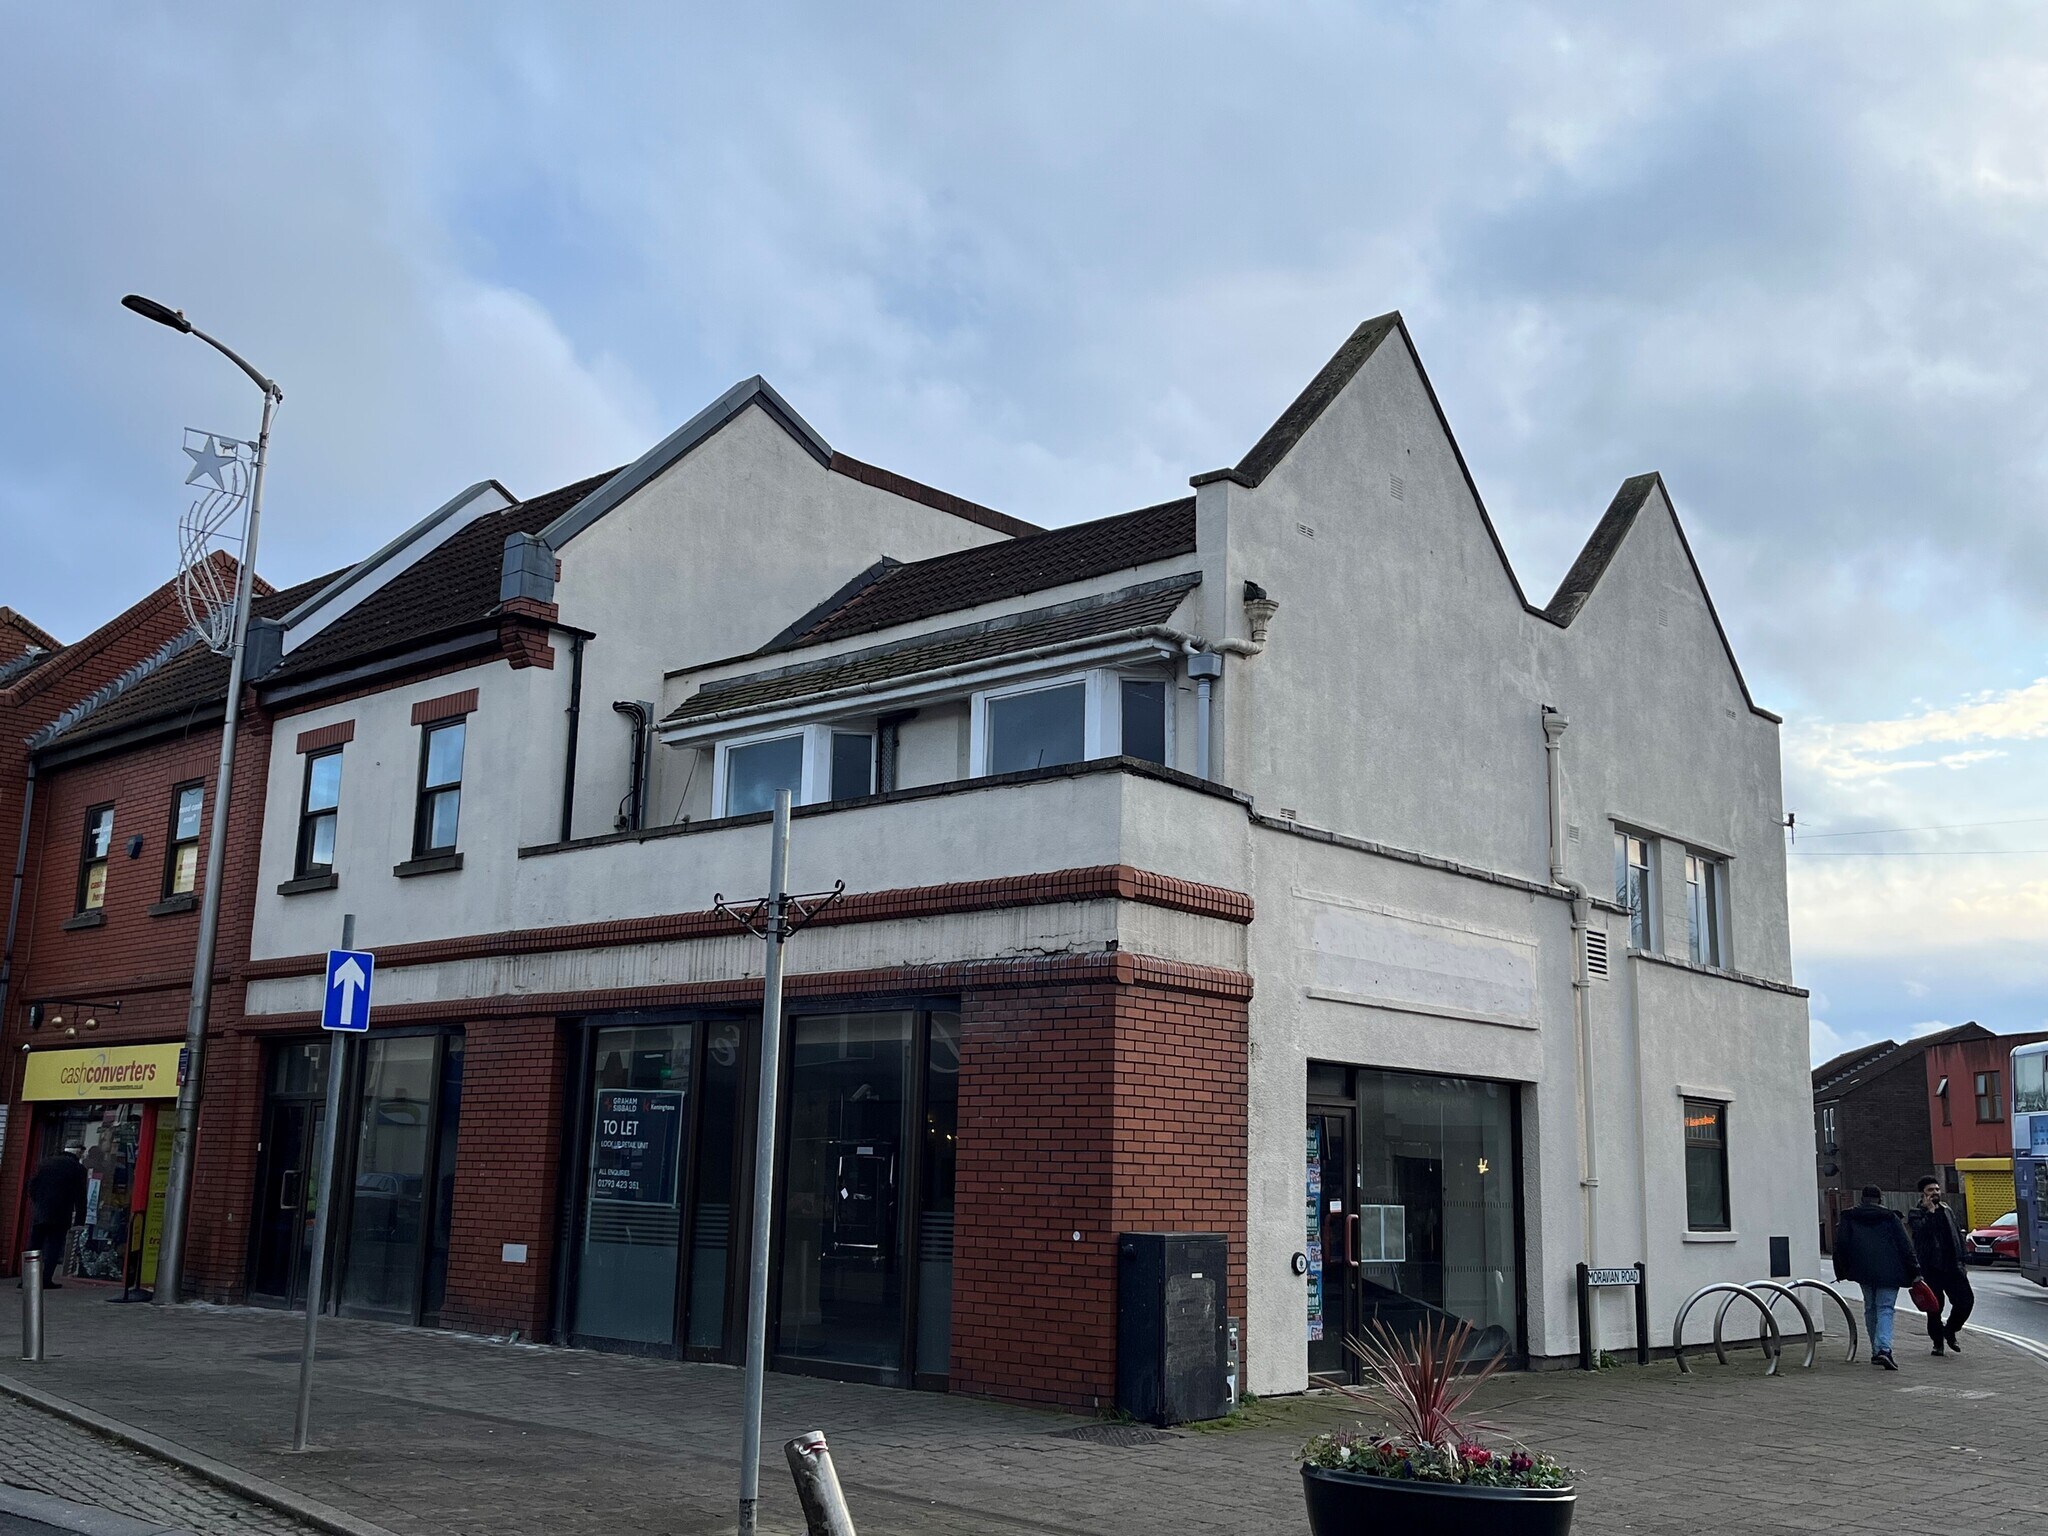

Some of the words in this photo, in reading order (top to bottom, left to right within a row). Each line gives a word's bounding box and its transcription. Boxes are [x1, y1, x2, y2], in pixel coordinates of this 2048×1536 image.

[612, 1097, 638, 1105] GRAHAM
[612, 1104, 638, 1112] SIBBALD
[603, 1120, 618, 1135] TO
[620, 1120, 639, 1136] LET
[597, 1179, 615, 1188] 01793
[616, 1181, 628, 1189] 423
[1588, 1271, 1620, 1283] MORAVIAN
[1621, 1270, 1639, 1282] ROAD
